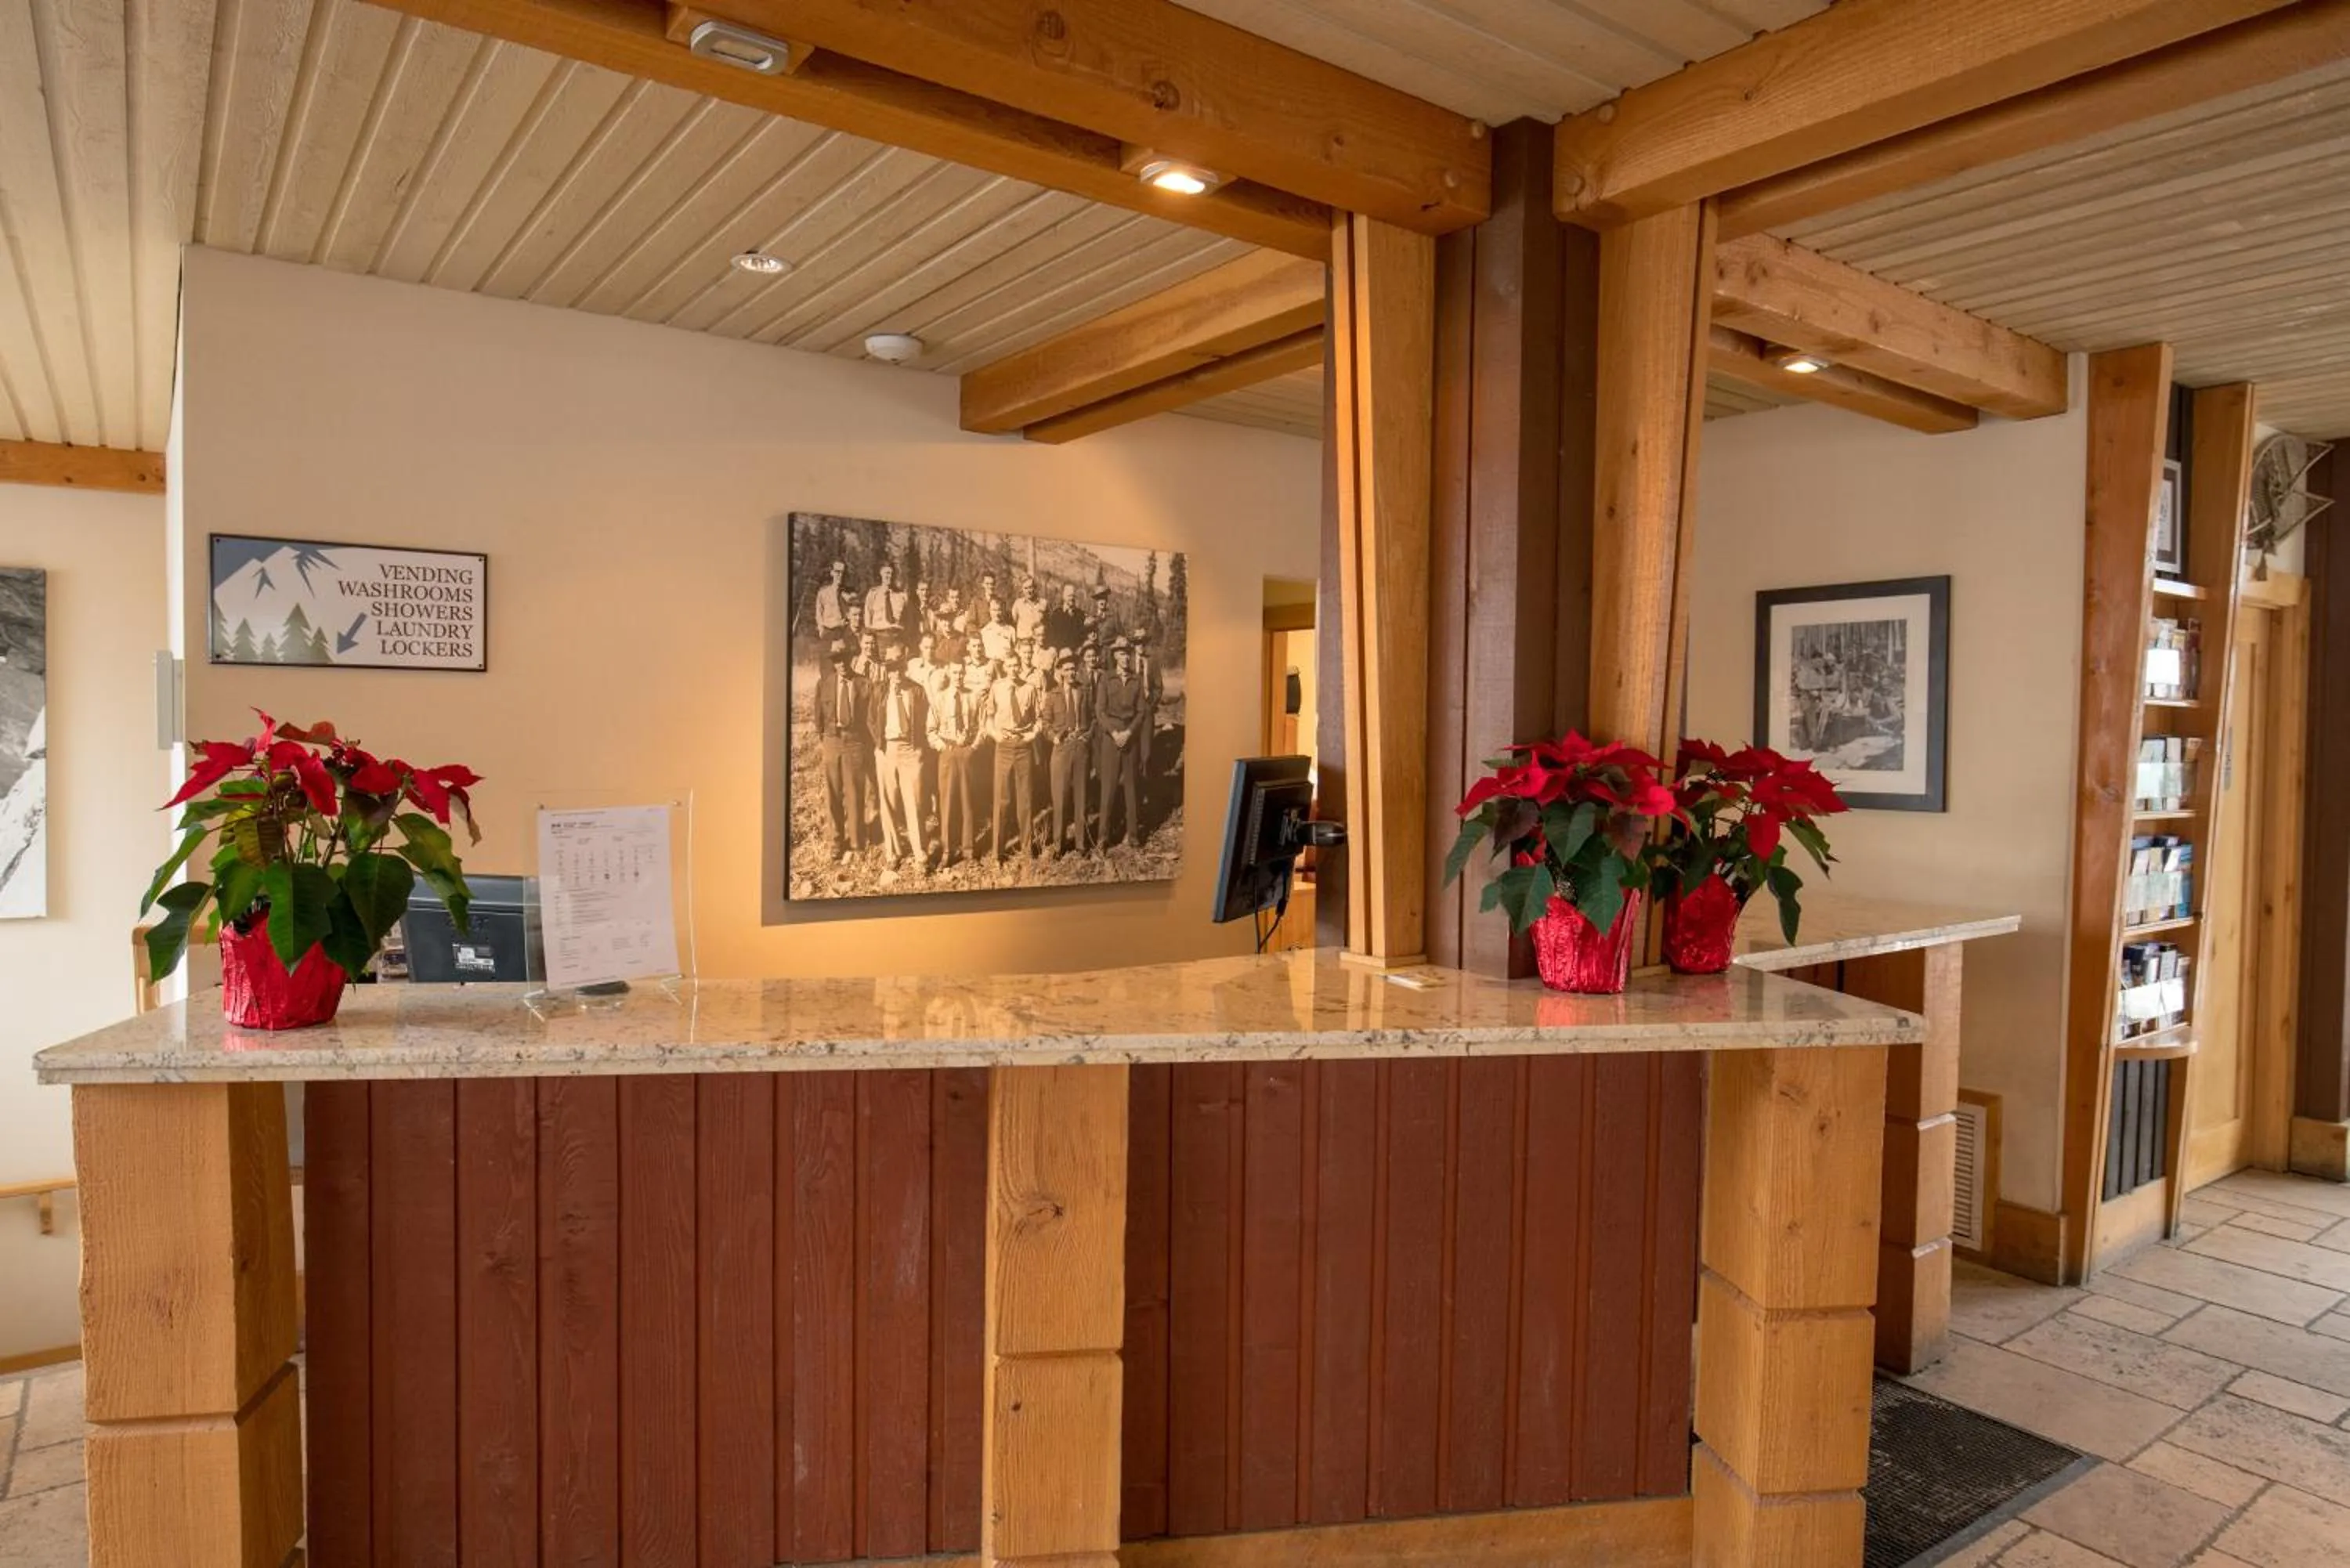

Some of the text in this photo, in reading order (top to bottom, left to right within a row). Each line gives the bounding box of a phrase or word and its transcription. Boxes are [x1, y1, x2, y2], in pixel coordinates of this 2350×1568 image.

[379, 563, 473, 584] VENDING
[338, 580, 472, 602] WASHROOMS
[371, 601, 472, 621] SHOWERS
[376, 620, 474, 640] LAUNDRY
[381, 639, 472, 657] LOCKERS
